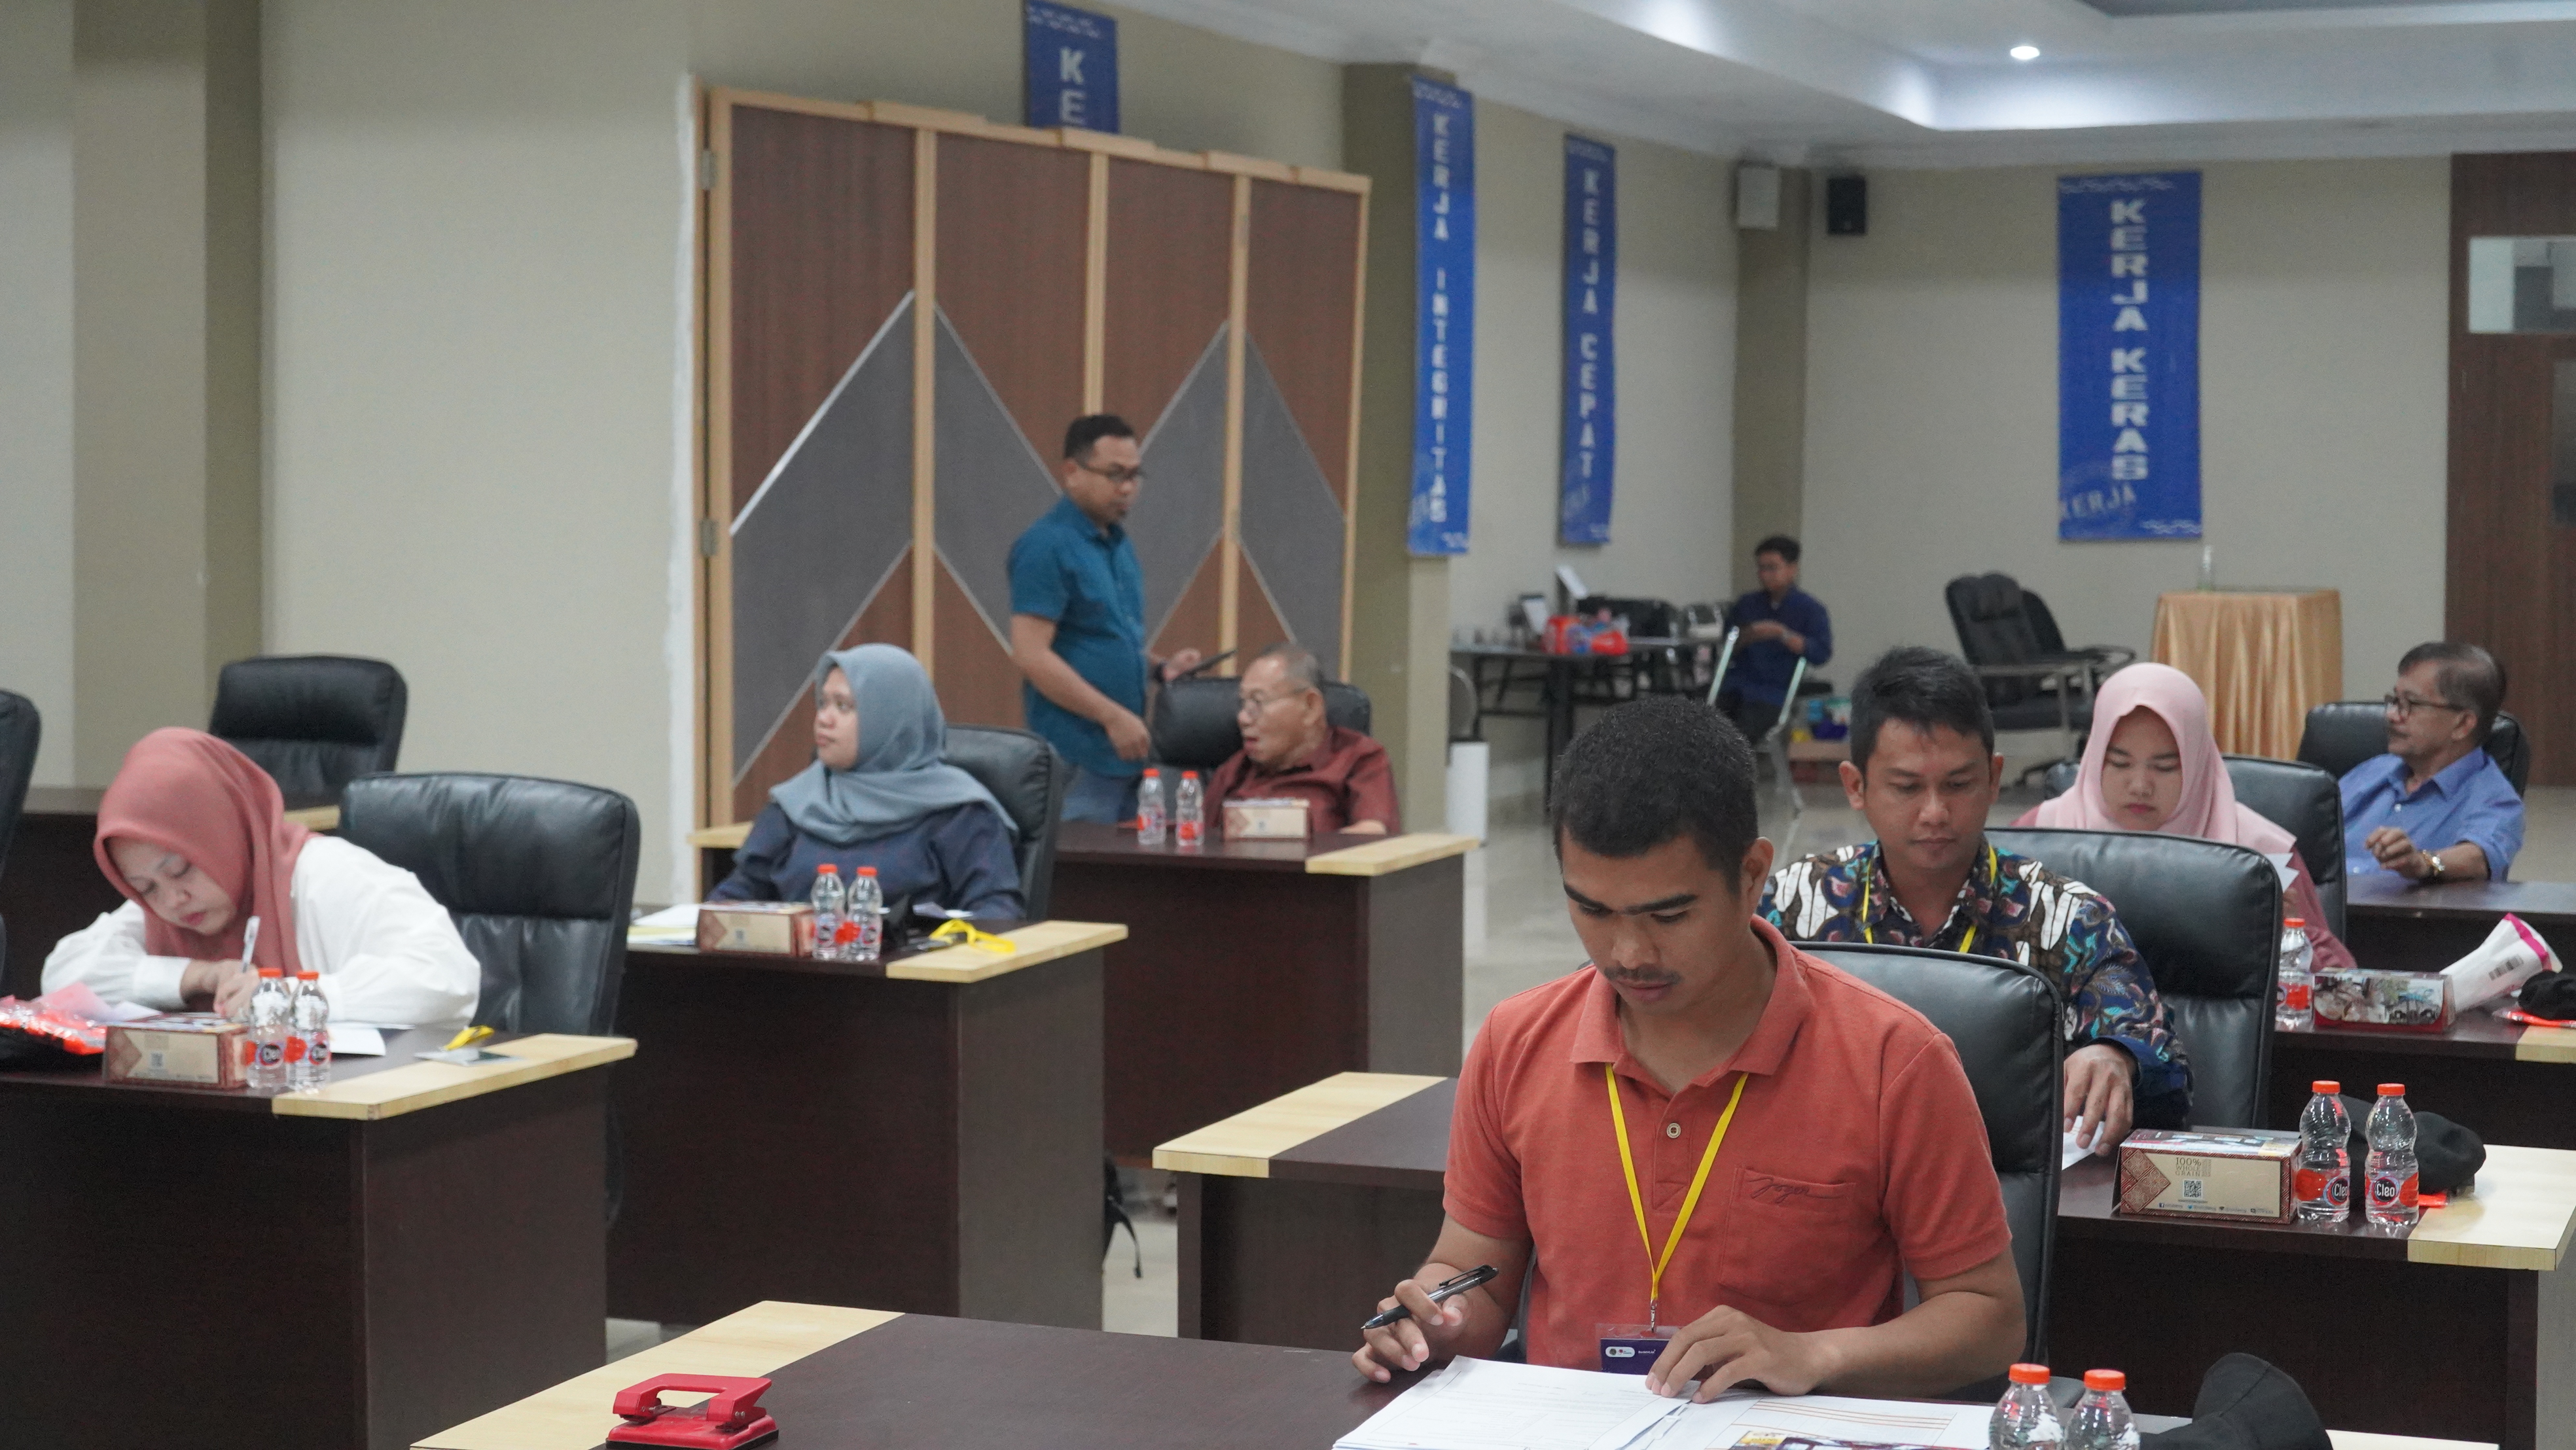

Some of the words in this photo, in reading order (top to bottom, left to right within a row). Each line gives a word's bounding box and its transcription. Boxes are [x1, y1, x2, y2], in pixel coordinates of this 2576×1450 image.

[1433, 113, 1450, 241] KERJA
[1583, 167, 1600, 315] KERJA
[2111, 199, 2149, 332] KERJA
[1429, 266, 1449, 523] INTEGRITAS
[1579, 332, 1598, 478] CEPAT
[2111, 347, 2149, 480] KERAS
[2175, 1158, 2202, 1166] 100%
[2376, 1183, 2395, 1197] Cleo
